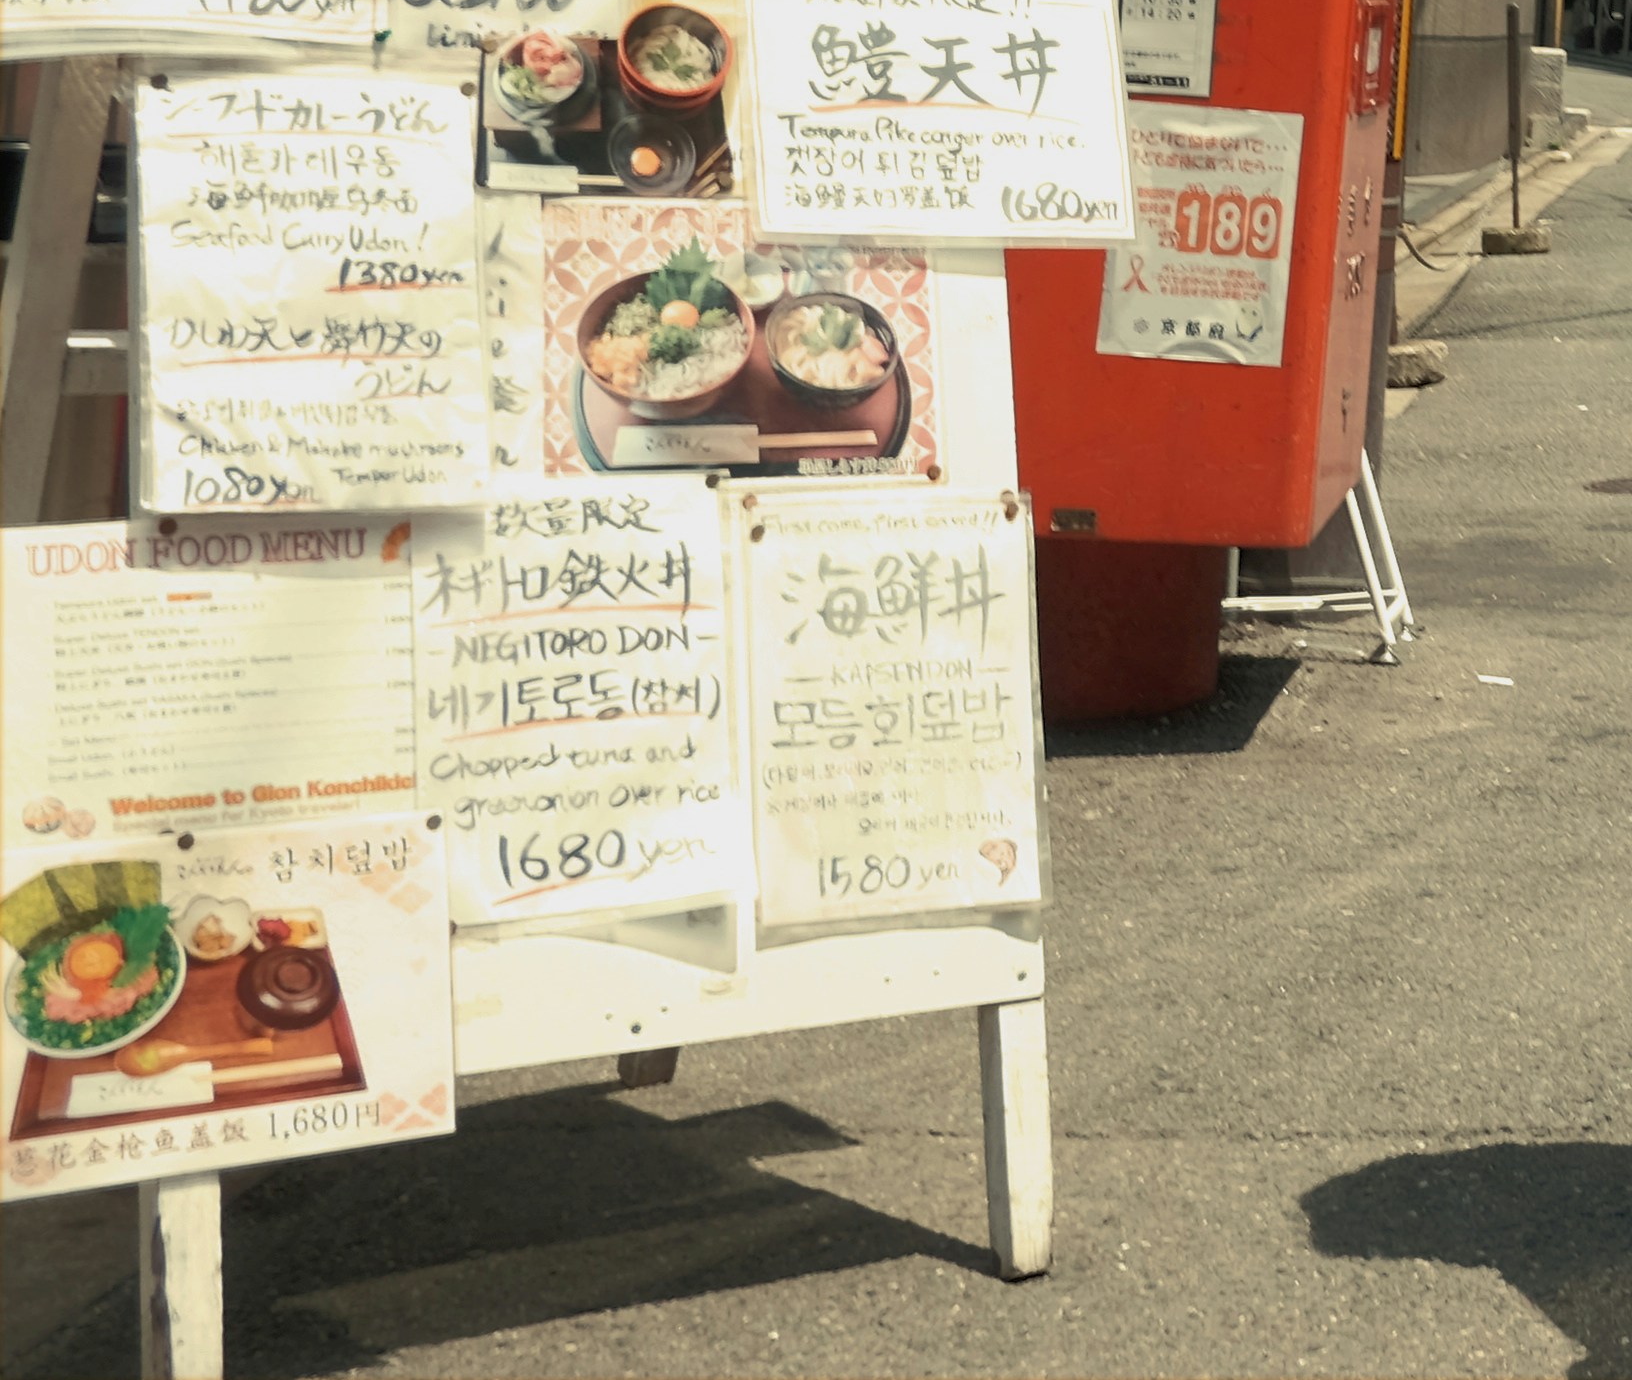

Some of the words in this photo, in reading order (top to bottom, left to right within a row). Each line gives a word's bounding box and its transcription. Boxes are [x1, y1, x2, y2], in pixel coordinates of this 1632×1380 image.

[26, 537, 137, 579] UDON
[147, 532, 254, 569] FOOD
[260, 527, 368, 567] MENU
[780, 542, 1007, 657] 海鮮丼
[617, 622, 690, 657] DON
[645, 732, 697, 762] and
[110, 792, 217, 817] Welcome
[221, 788, 246, 807] to
[252, 783, 302, 804] Gion
[266, 1099, 382, 1142] 1,680円
